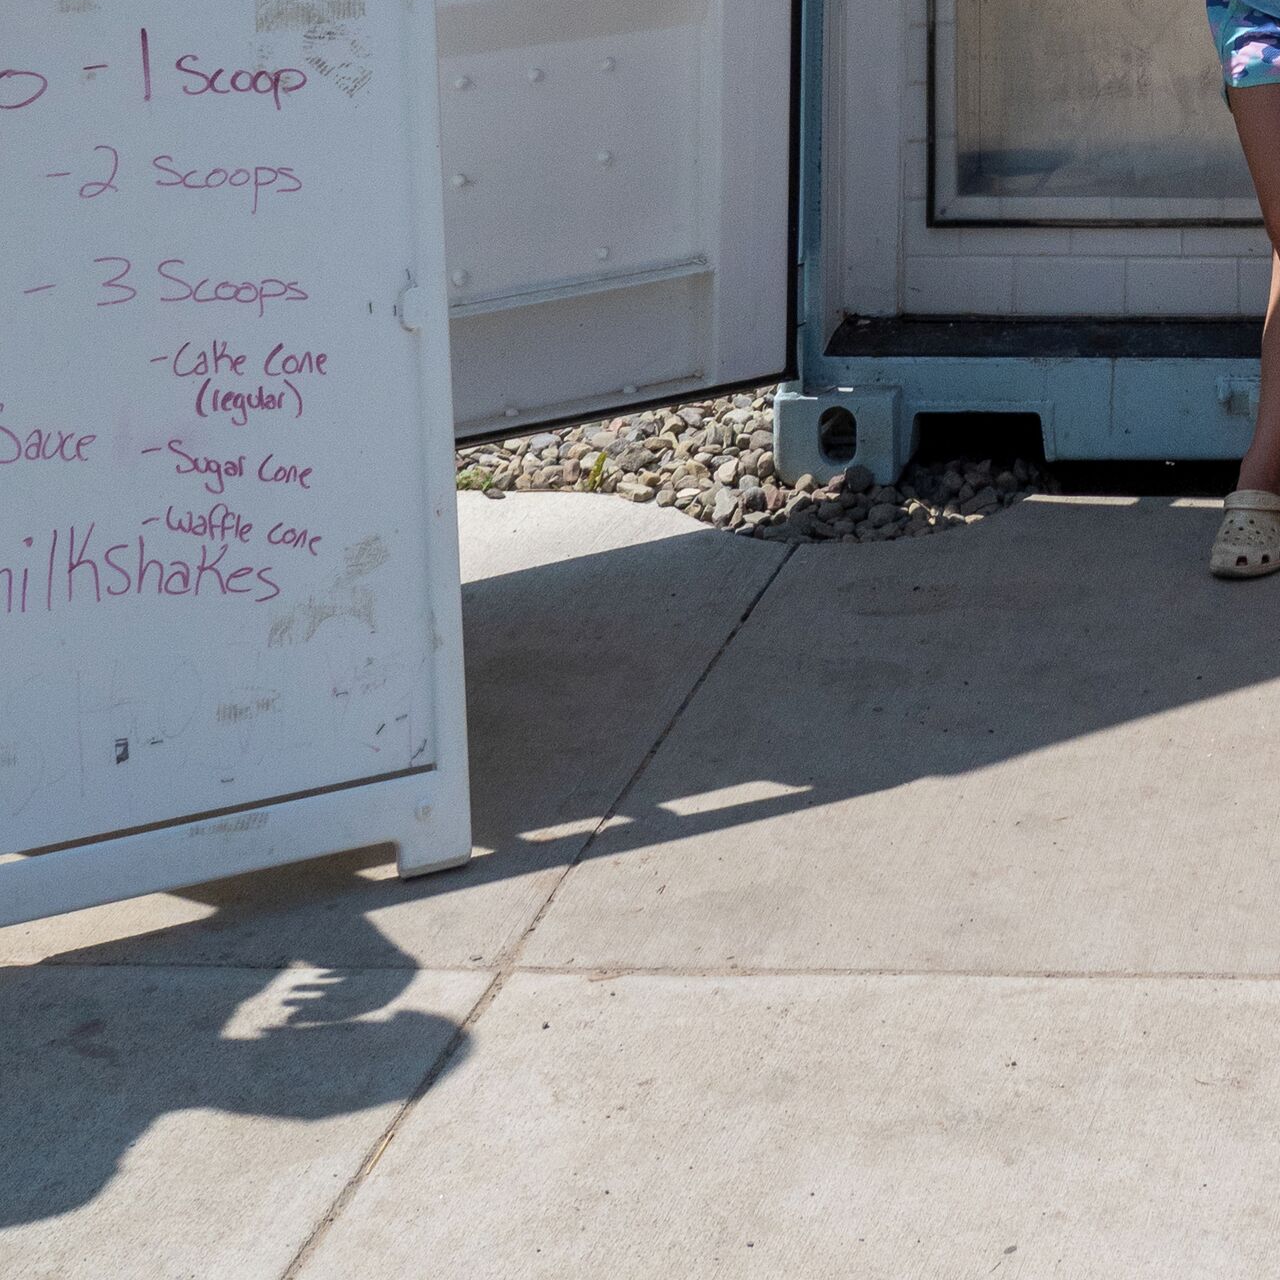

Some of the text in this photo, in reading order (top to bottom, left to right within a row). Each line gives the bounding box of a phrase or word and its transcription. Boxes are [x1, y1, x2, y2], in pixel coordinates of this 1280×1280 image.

[175, 54, 307, 110] Scoop
[152, 155, 302, 215] Scoops
[93, 256, 137, 306] 3
[158, 259, 308, 317] Scoops
[195, 377, 303, 426] (regular)
